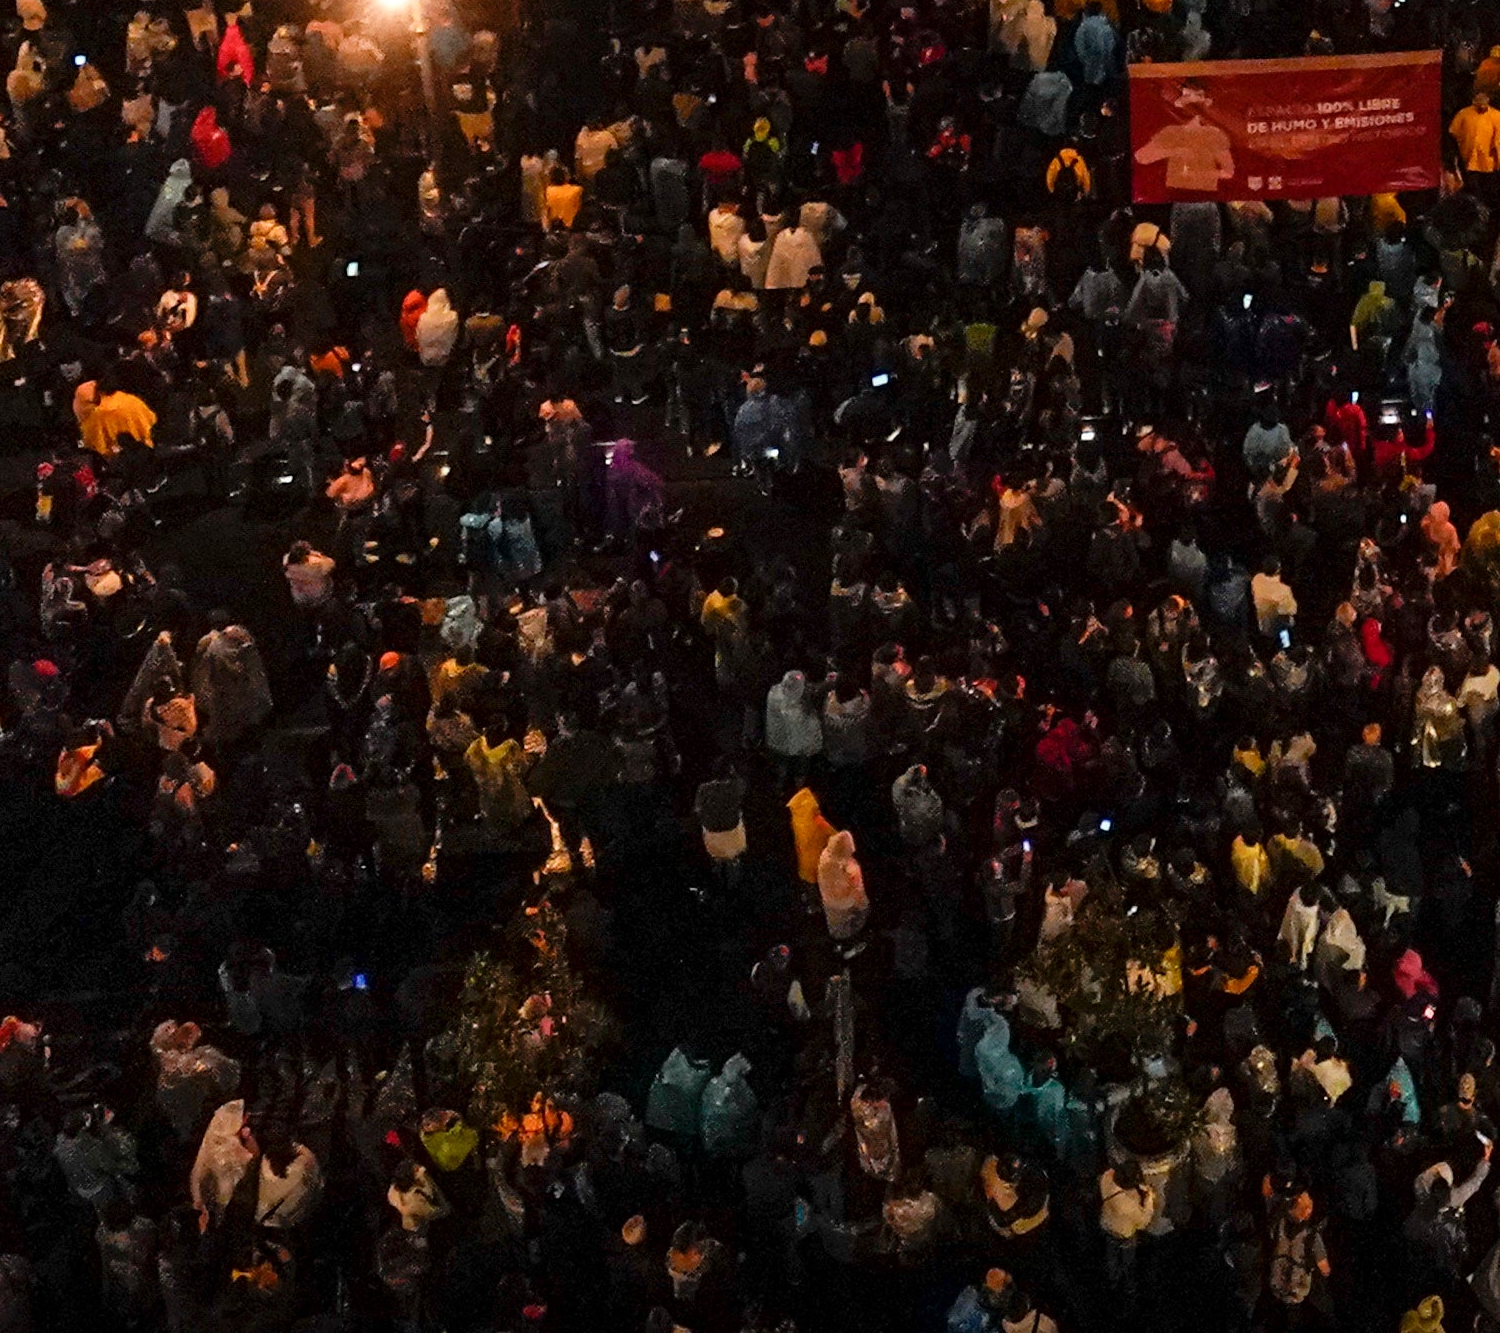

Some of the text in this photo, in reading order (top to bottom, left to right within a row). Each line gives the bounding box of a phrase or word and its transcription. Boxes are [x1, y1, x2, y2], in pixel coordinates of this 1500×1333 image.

[1317, 100, 1354, 115] 100%
[1358, 97, 1401, 112] LIBRE
[1246, 111, 1415, 135] DE HUMO Y EMISIONES
